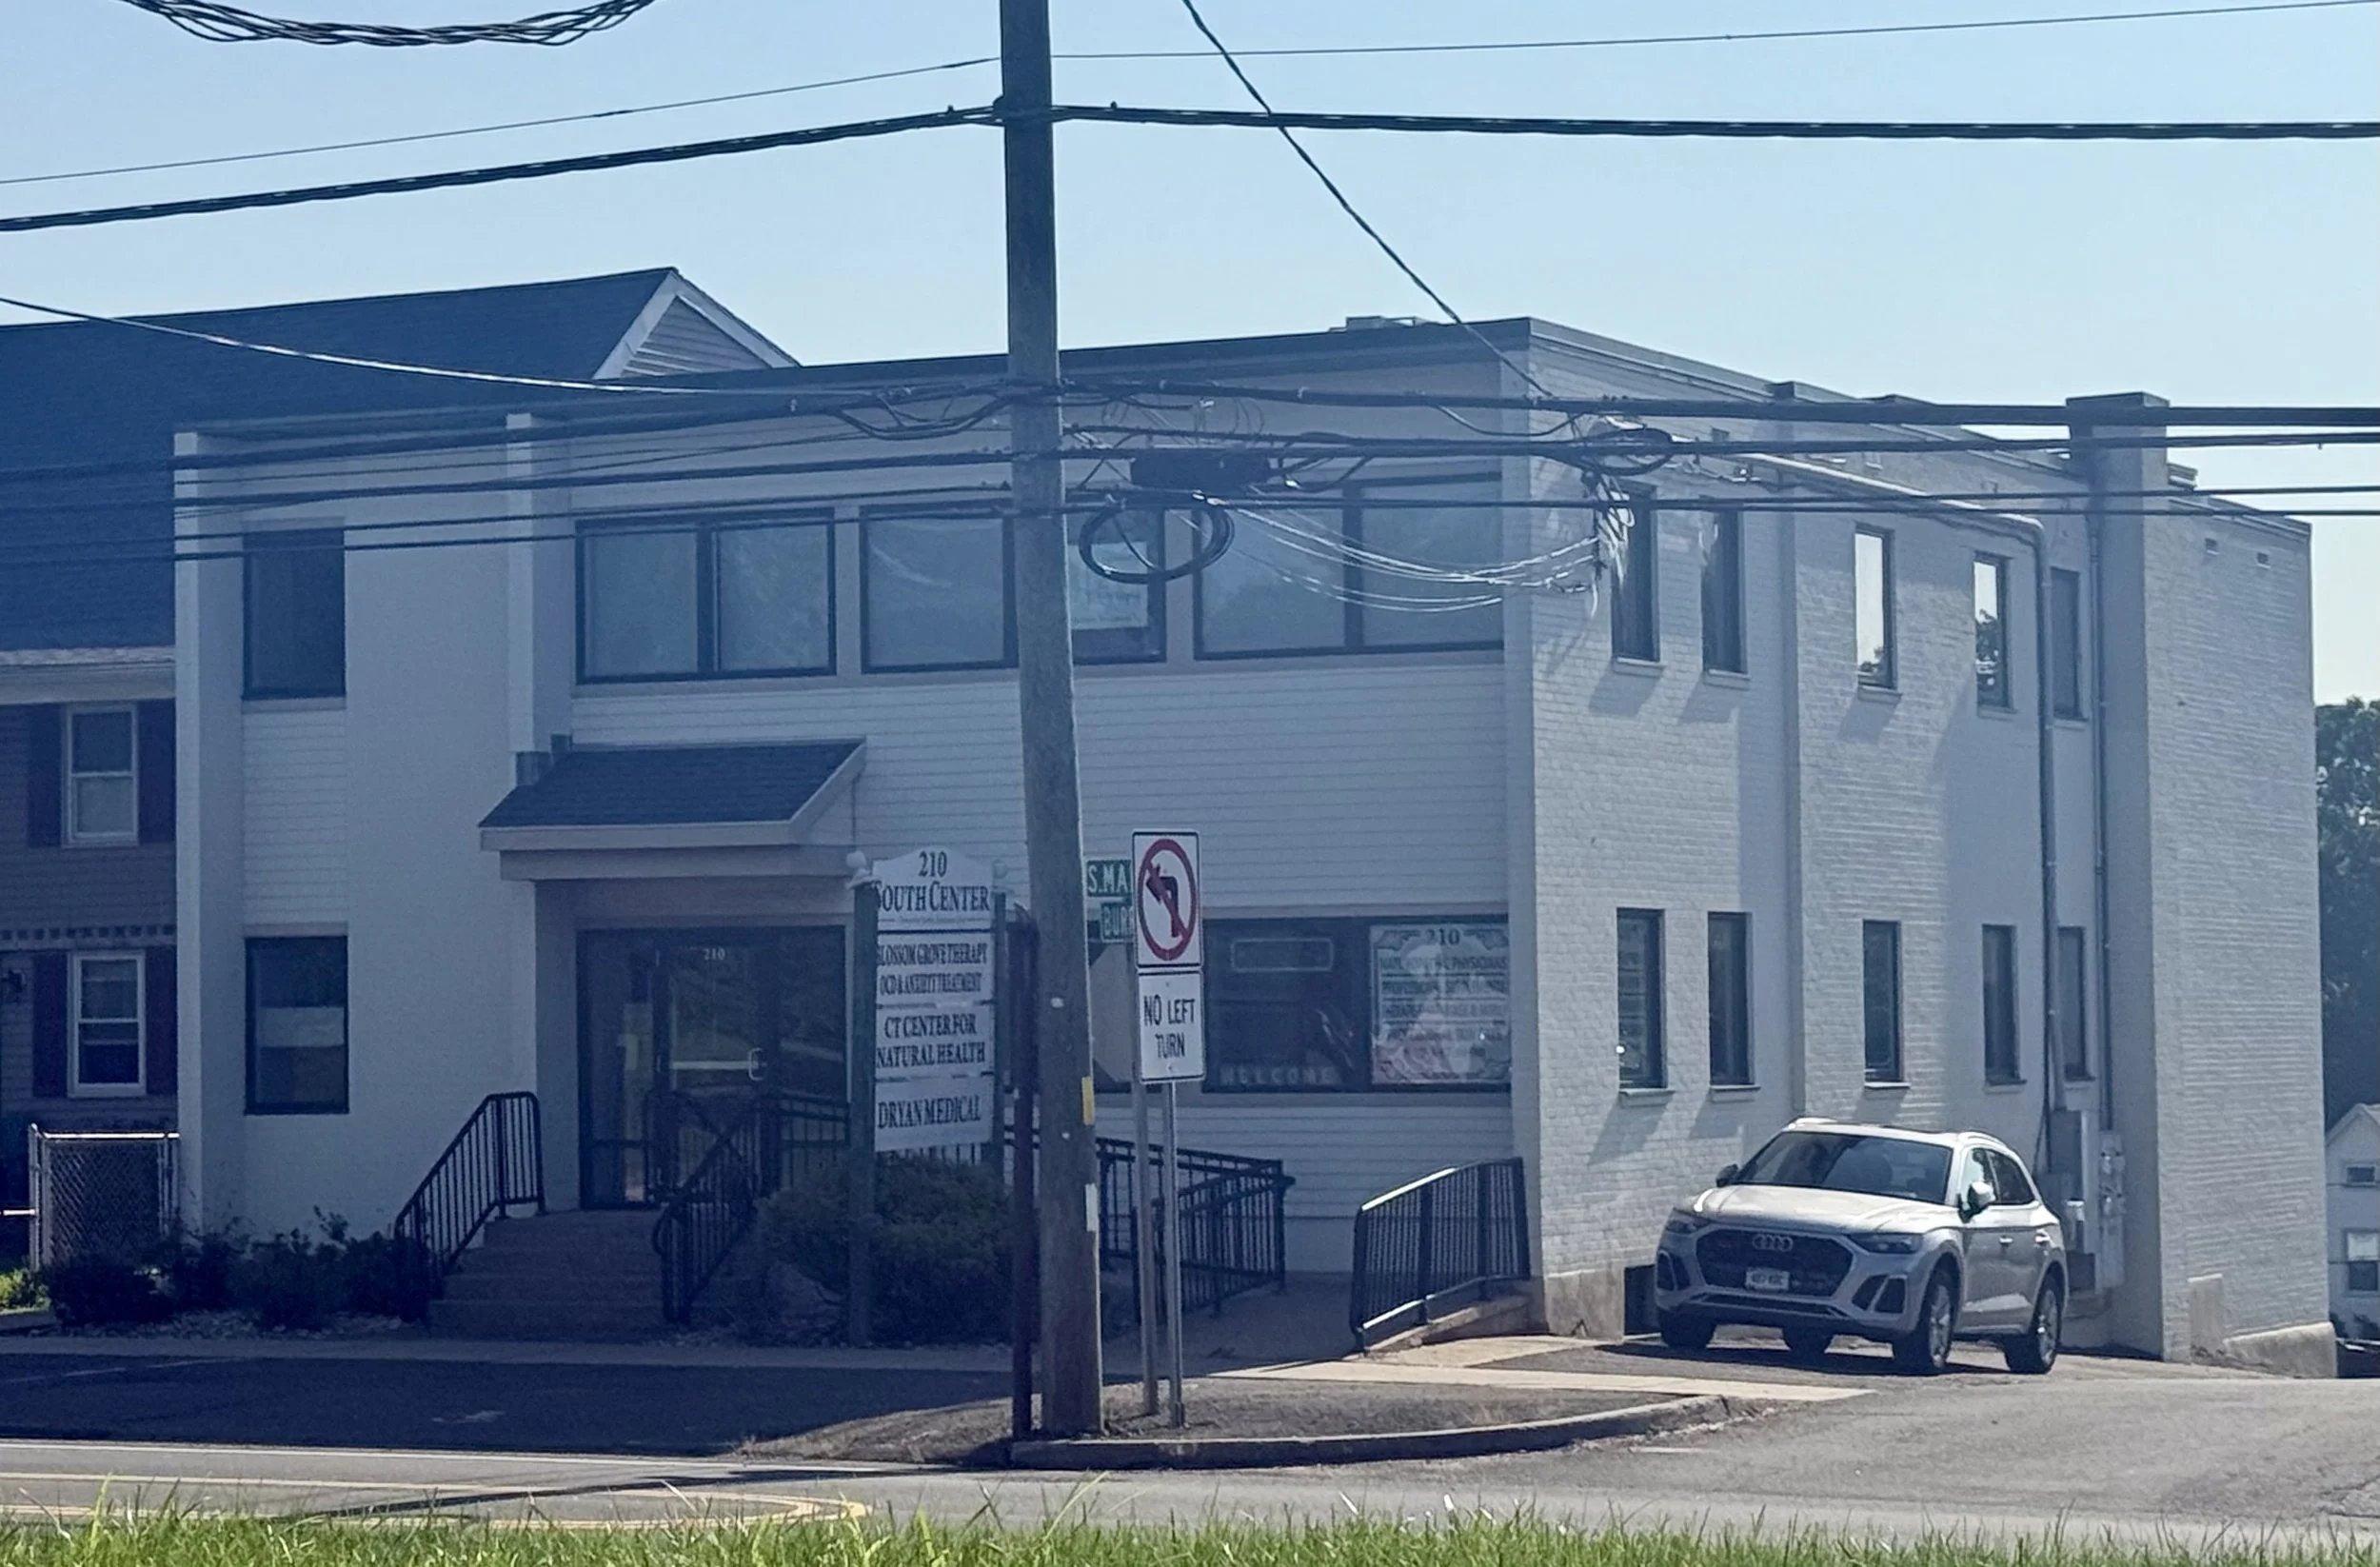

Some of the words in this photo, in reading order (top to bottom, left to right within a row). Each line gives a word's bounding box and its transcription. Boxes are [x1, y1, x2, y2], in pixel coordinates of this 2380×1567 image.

[918, 850, 948, 877] 210
[928, 881, 991, 912] CENTER
[703, 947, 725, 961] 210
[1143, 994, 1162, 1026] NO
[1167, 998, 1196, 1024] LEFT
[883, 1016, 902, 1040] CT
[902, 1014, 950, 1038] CENTER
[952, 1013, 977, 1035] FOR
[876, 1043, 935, 1068] NATURAL
[937, 1041, 985, 1064] HEALTH
[1155, 1032, 1185, 1059] TURN
[1219, 1065, 1336, 1085] WELCOME
[922, 1094, 982, 1126] MEDICAL
